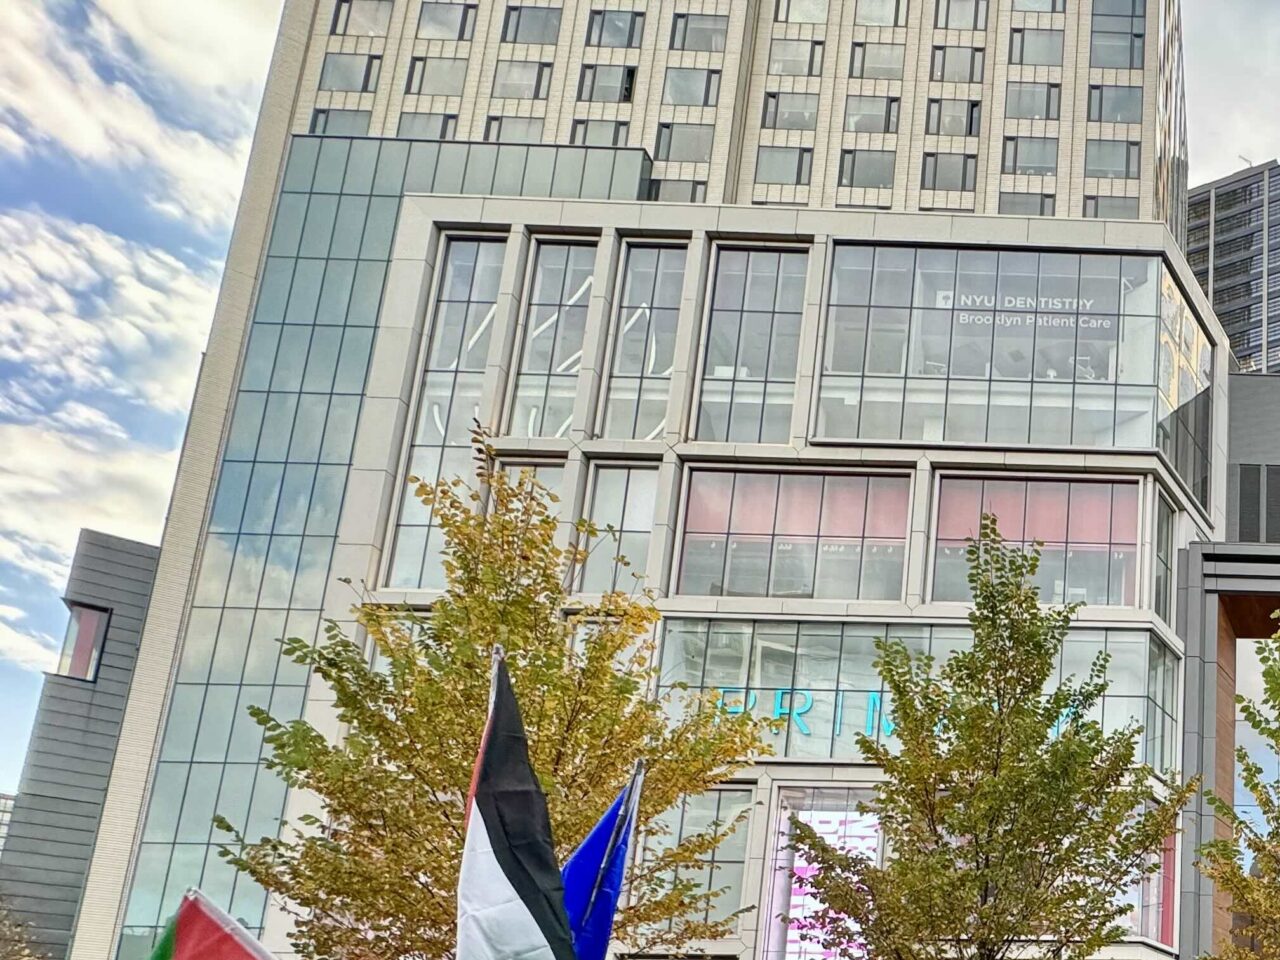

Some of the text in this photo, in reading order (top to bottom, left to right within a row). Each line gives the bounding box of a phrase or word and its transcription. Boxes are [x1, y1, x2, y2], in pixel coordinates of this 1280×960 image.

[960, 294, 1094, 310] NYU DENTISTRY
[1025, 315, 1075, 327] Patient
[1078, 316, 1111, 328] Care
